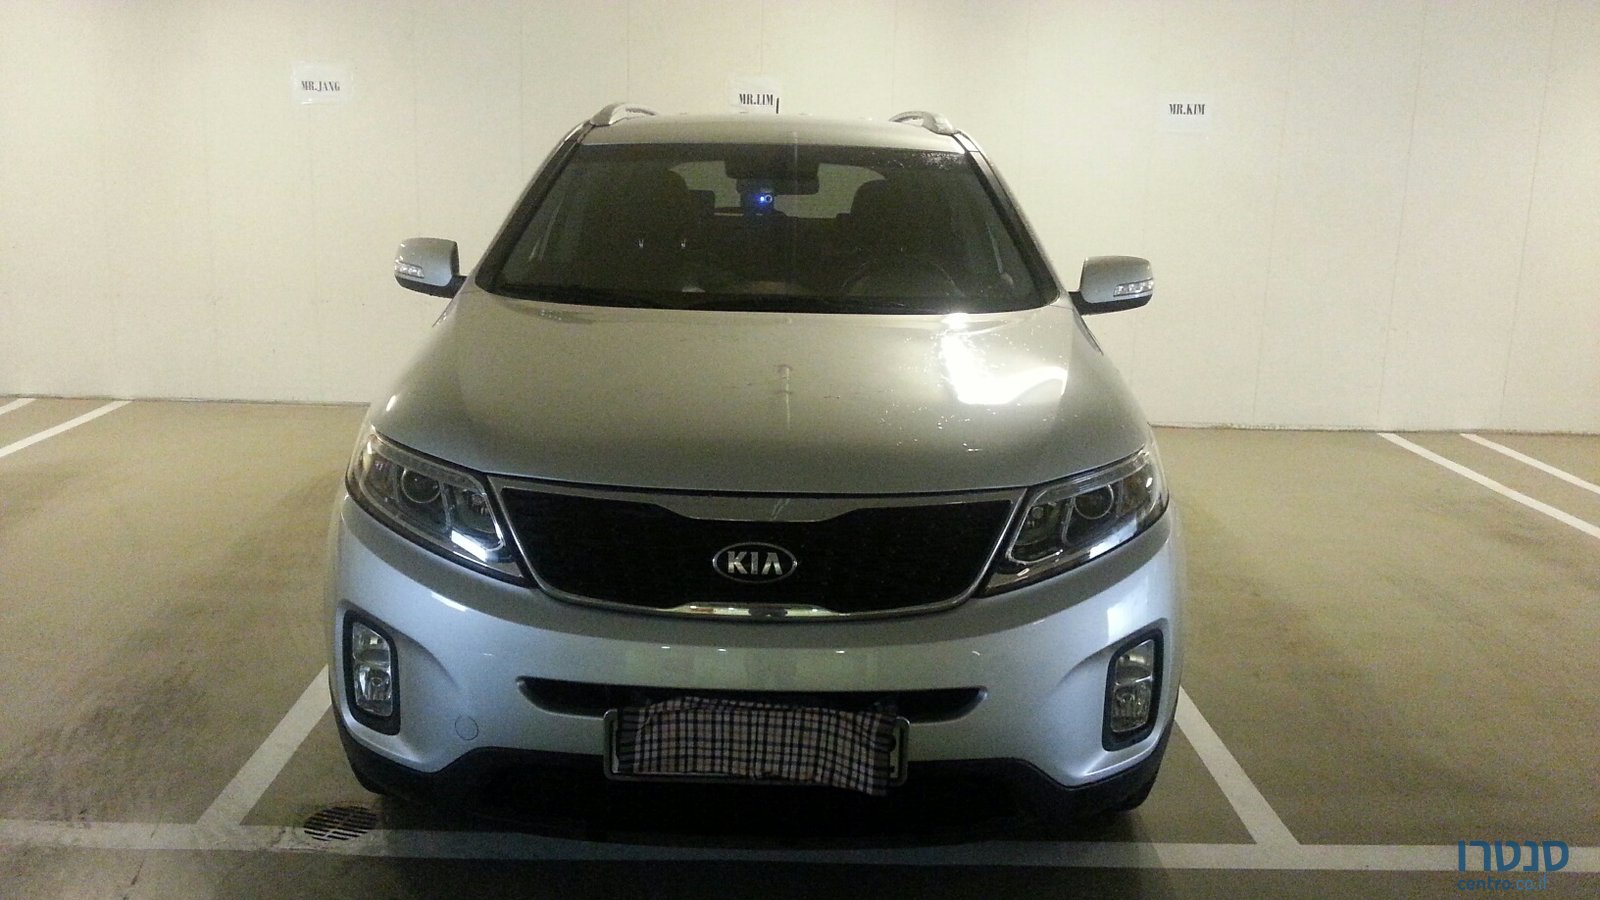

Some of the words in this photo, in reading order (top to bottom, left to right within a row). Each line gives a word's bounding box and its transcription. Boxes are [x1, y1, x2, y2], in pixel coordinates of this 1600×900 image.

[301, 80, 341, 92] MR.JANG
[739, 93, 774, 105] MR.LIM
[1169, 103, 1206, 115] MR.KIM
[727, 551, 783, 575] KIA
